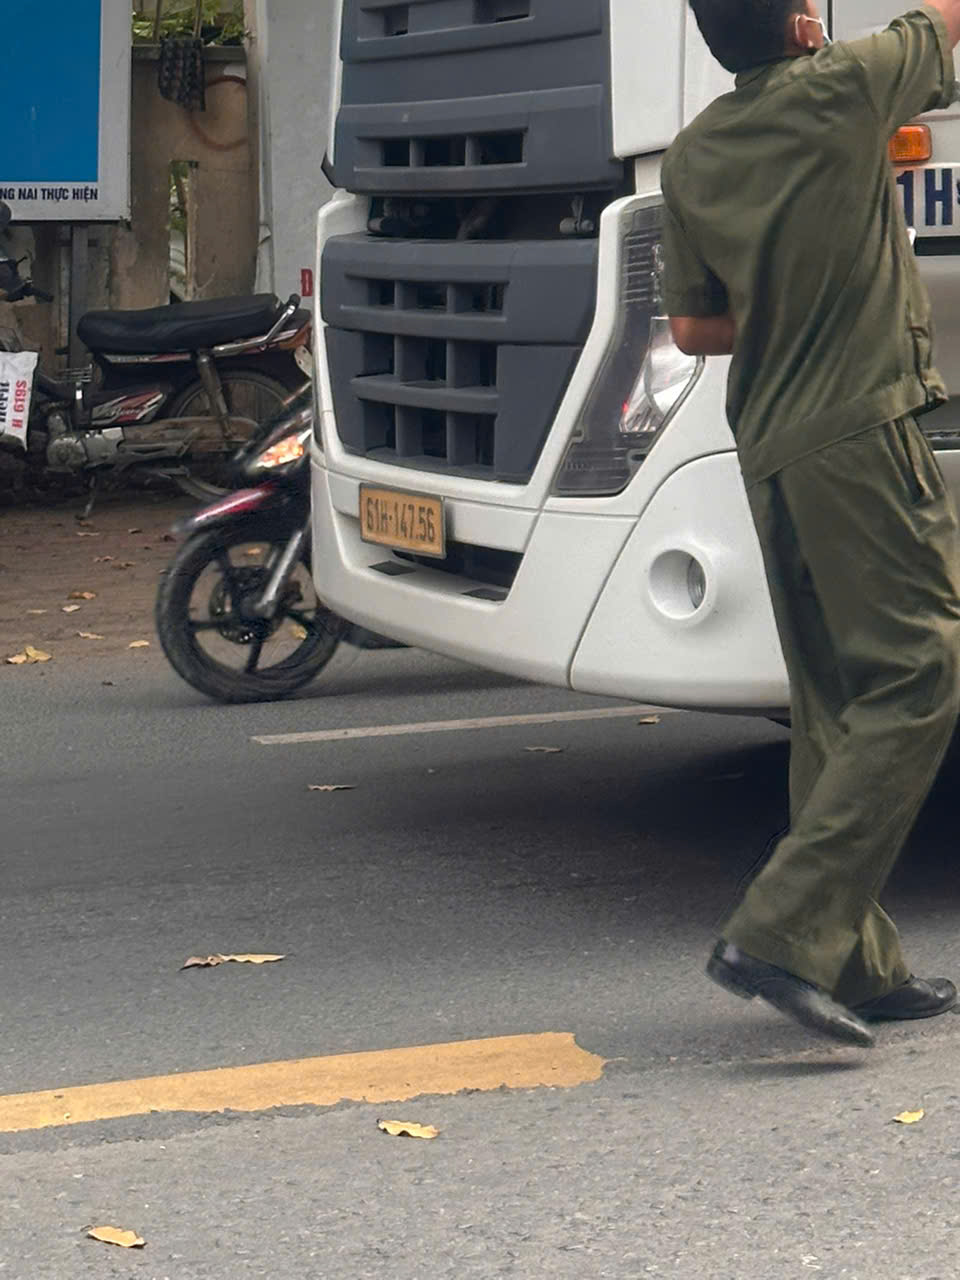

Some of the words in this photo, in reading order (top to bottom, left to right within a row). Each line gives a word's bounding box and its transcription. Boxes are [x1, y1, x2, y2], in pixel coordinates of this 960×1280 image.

[18, 187, 37, 200] NAI
[41, 186, 69, 202] THỰC
[72, 185, 98, 203] HIỆN
